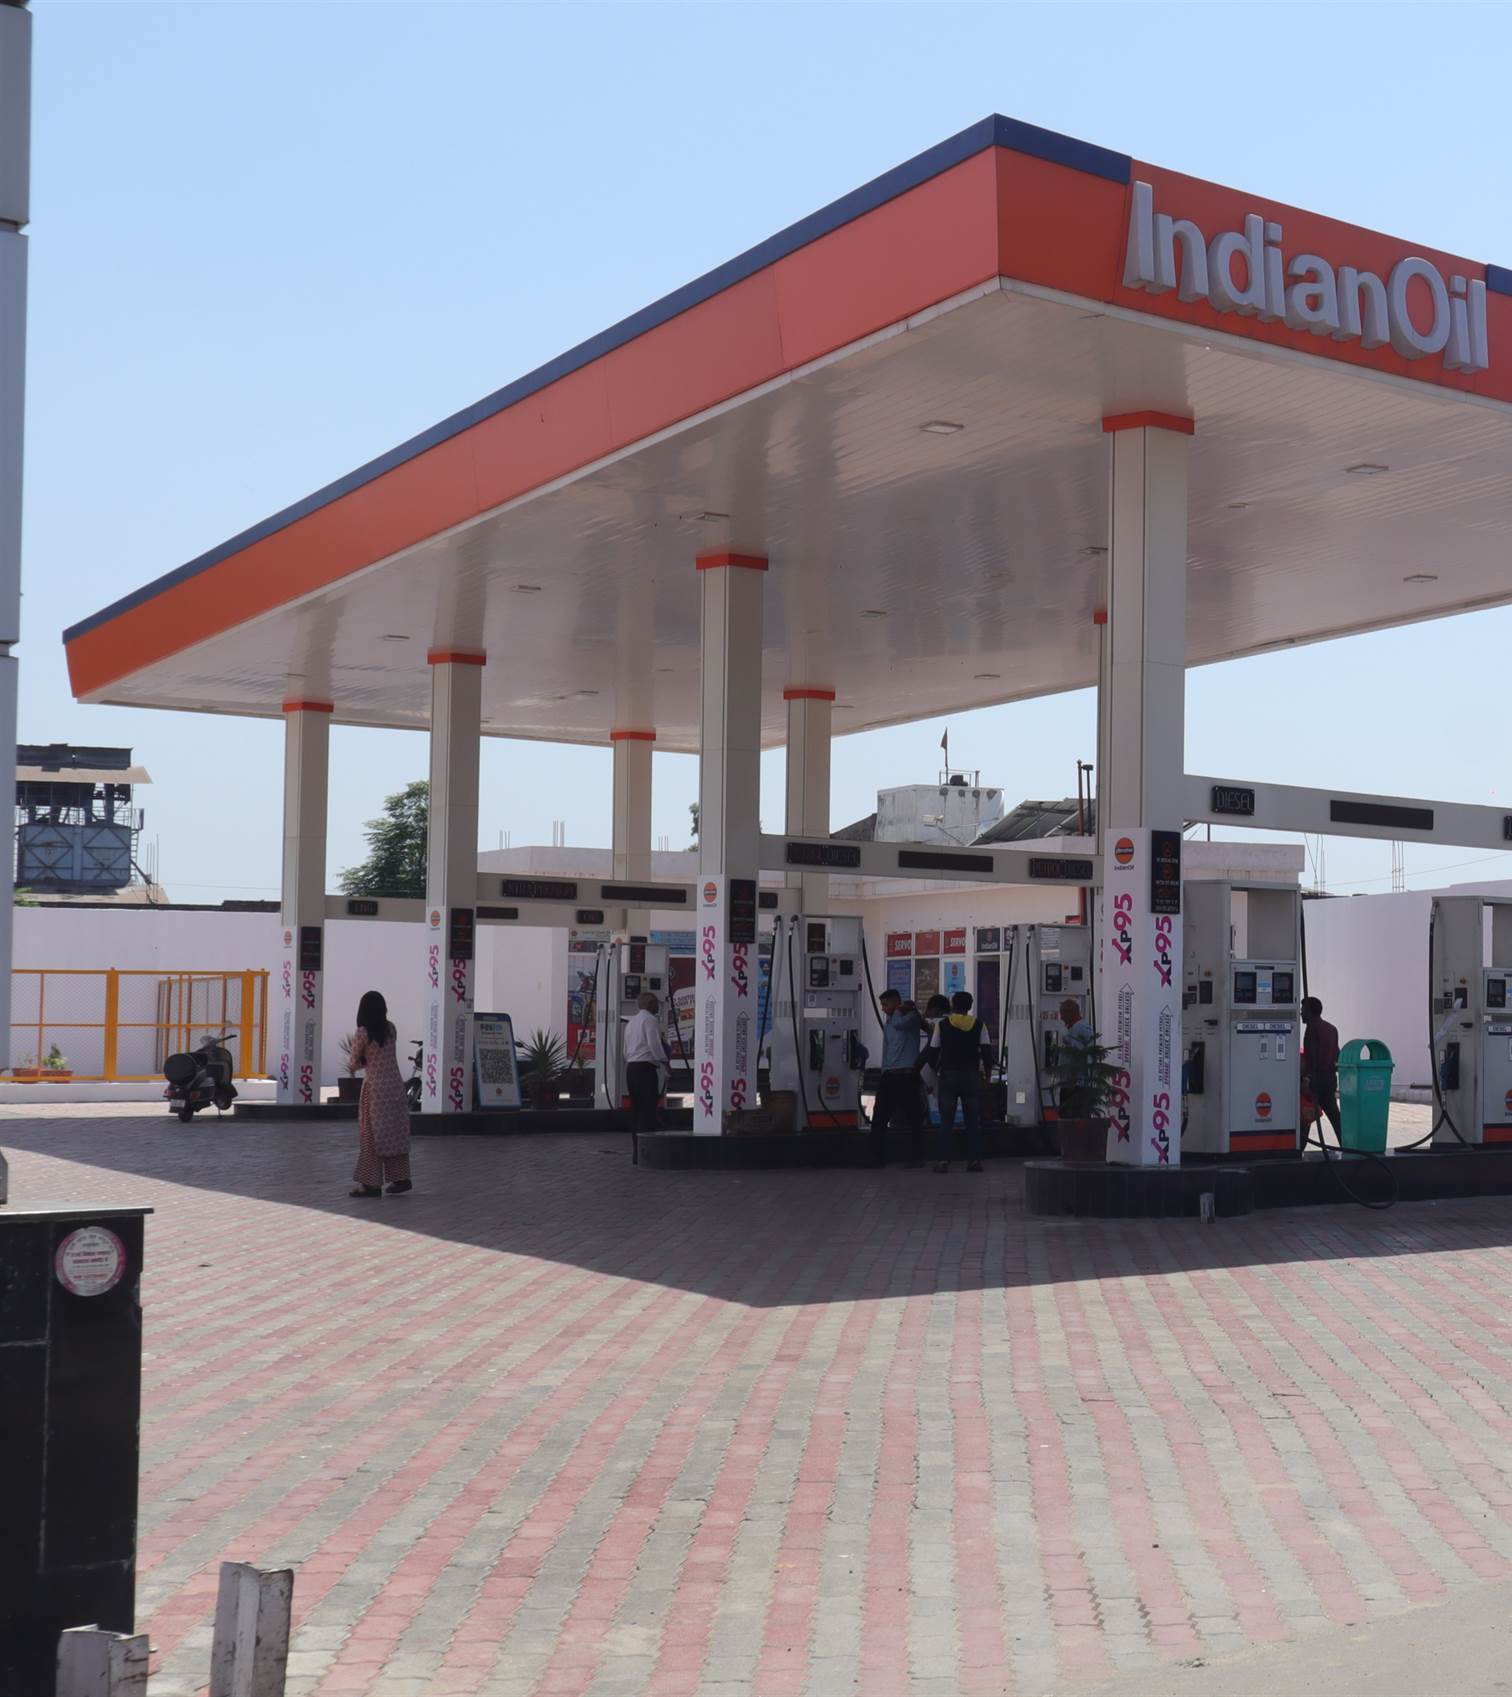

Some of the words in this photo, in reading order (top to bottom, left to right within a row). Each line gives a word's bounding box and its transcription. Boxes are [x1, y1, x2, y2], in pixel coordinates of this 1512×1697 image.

[1122, 180, 1489, 374] IndianOil
[1216, 790, 1253, 811] DIESEL
[702, 925, 716, 981] XP95
[1112, 893, 1132, 966] XP95
[1154, 915, 1172, 988] XP95
[302, 970, 316, 1008] XP95
[429, 945, 439, 989] XP95
[452, 959, 466, 1003] XP95
[732, 943, 748, 998] XP95
[299, 1064, 313, 1104] XP95
[427, 1053, 437, 1097] XP95
[449, 1066, 464, 1112] XP95
[700, 1062, 714, 1117] XP95
[1151, 1092, 1169, 1165] XP95
